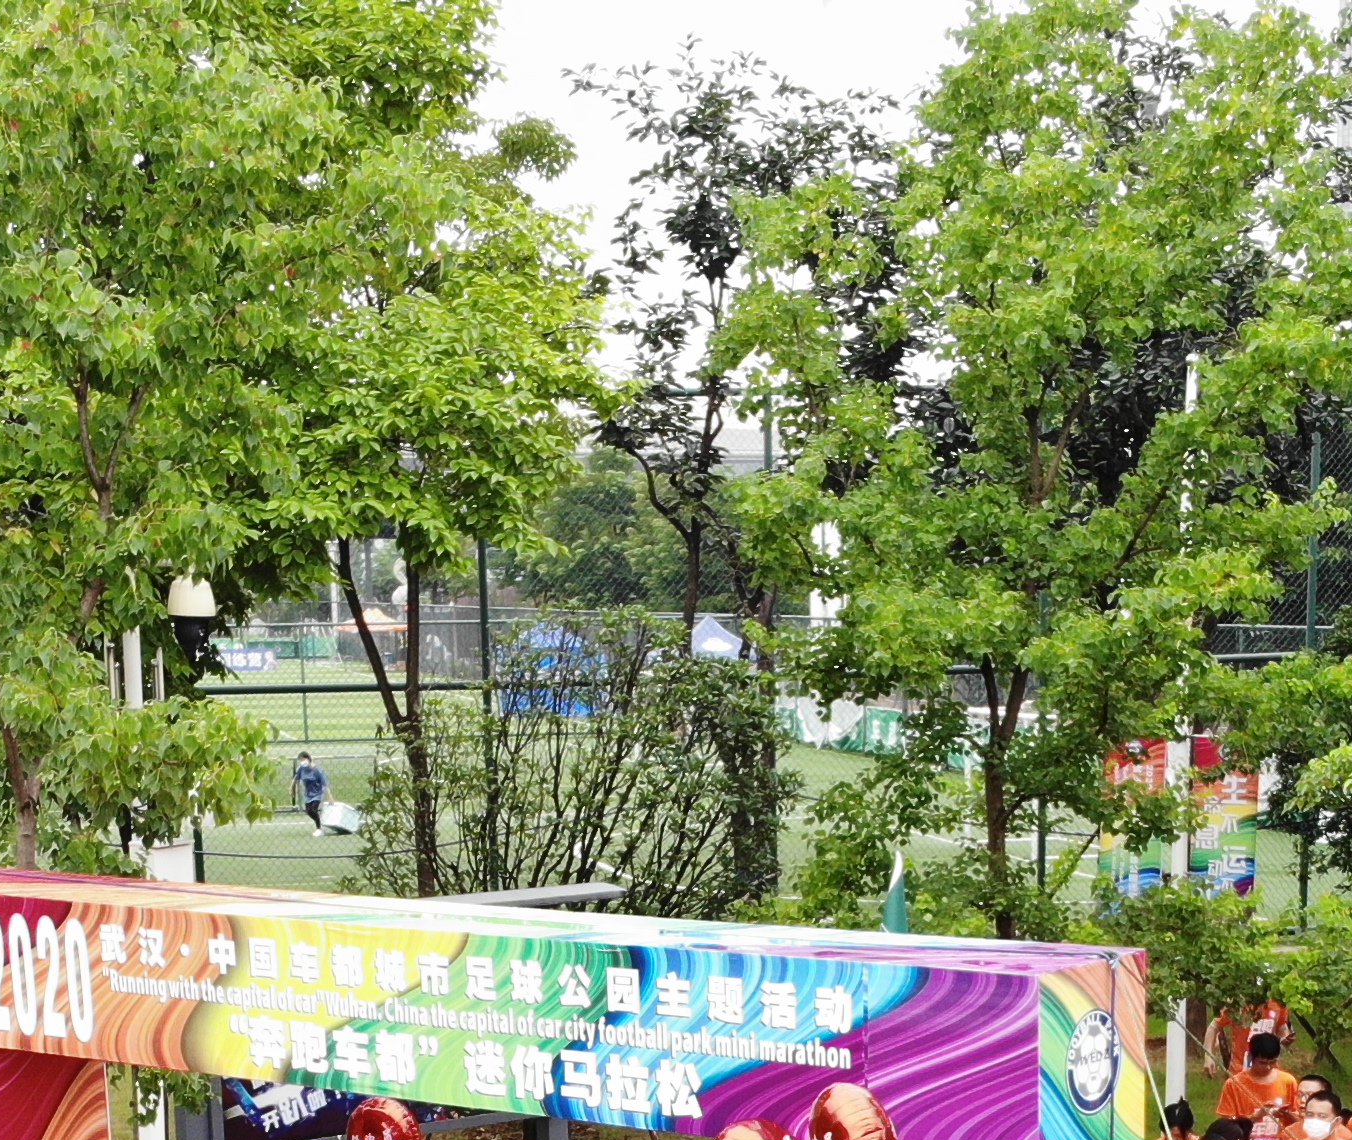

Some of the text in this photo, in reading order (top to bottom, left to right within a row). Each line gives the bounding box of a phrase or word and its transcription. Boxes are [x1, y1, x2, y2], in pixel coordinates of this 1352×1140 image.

[101, 968, 166, 1003] "Running
[167, 975, 199, 1001] with
[201, 978, 224, 1003] the
[226, 982, 277, 1013] capital
[279, 985, 295, 1012] of
[384, 996, 428, 1027] China
[430, 1001, 456, 1029] the
[459, 1006, 514, 1038] capital
[517, 1009, 535, 1036] of
[536, 1016, 562, 1039] car
[564, 1013, 596, 1049] city
[597, 1015, 668, 1051] football
[671, 1026, 711, 1058] park
[714, 1029, 756, 1060] mini
[758, 1037, 852, 1070] marathon
[463, 1040, 704, 1119] 迷你马拉松
